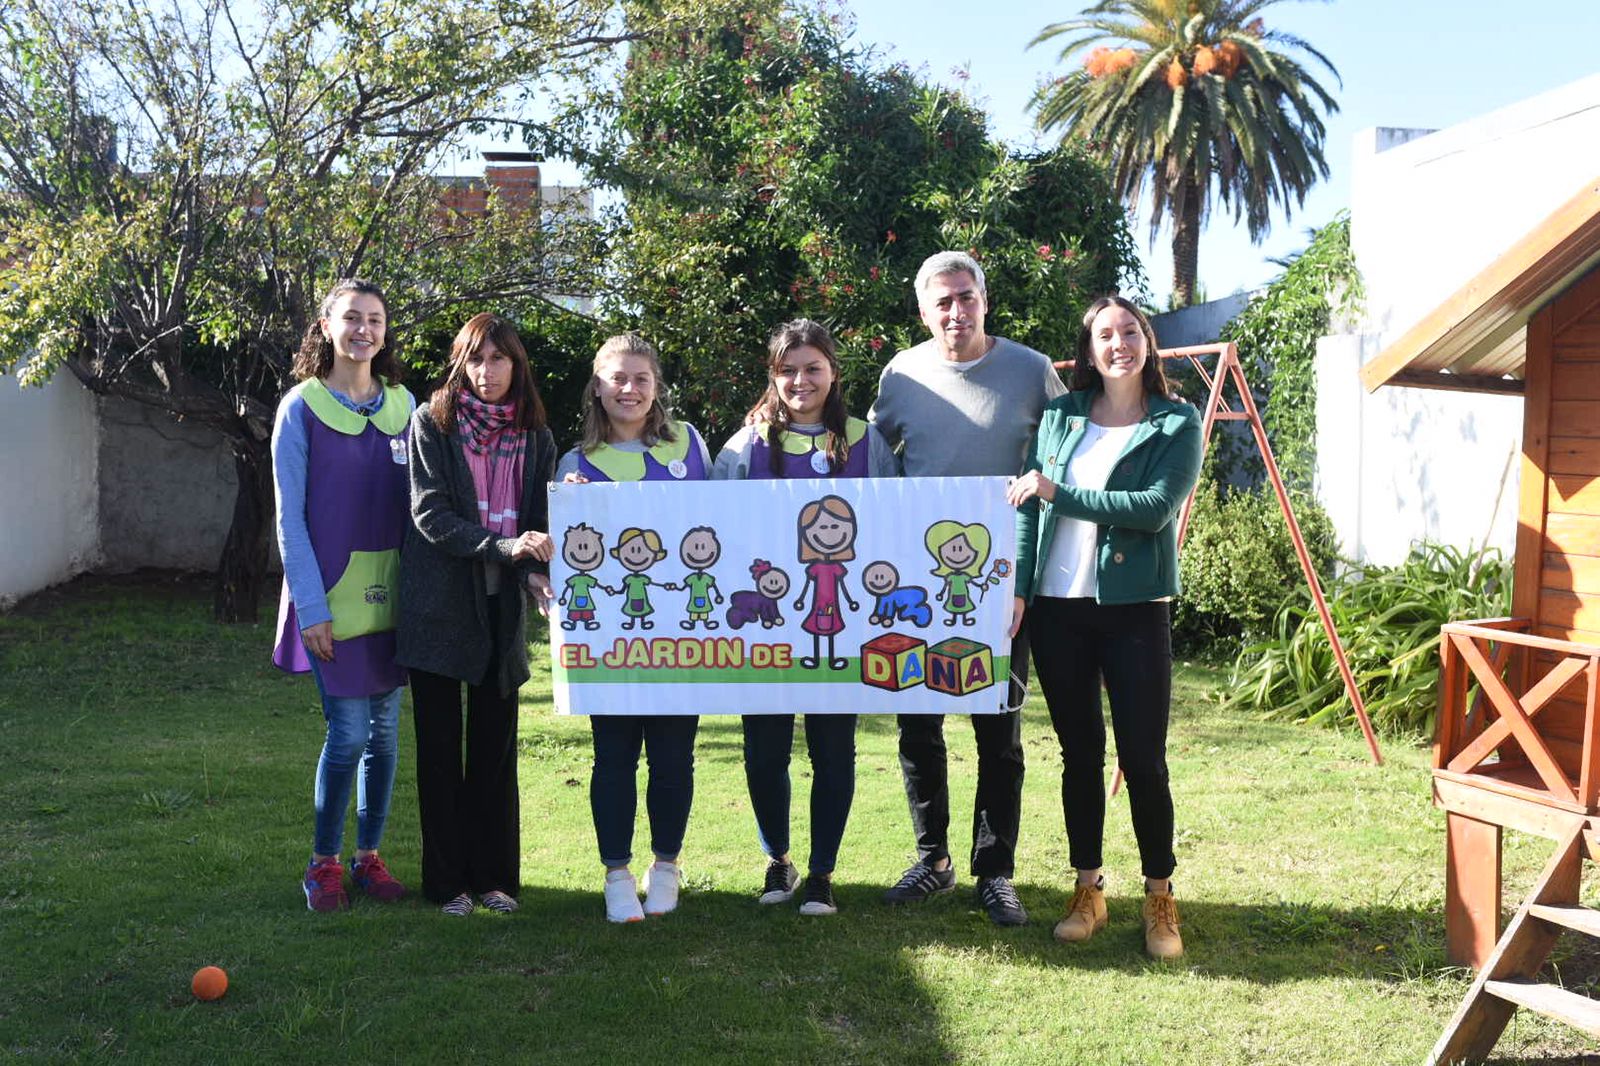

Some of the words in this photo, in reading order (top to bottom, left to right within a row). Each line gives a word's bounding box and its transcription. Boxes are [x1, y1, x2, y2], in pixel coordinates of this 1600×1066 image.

[561, 644, 597, 668] EL
[603, 637, 745, 669] JARDIN
[751, 644, 793, 668] DE
[866, 652, 988, 689] DANA
